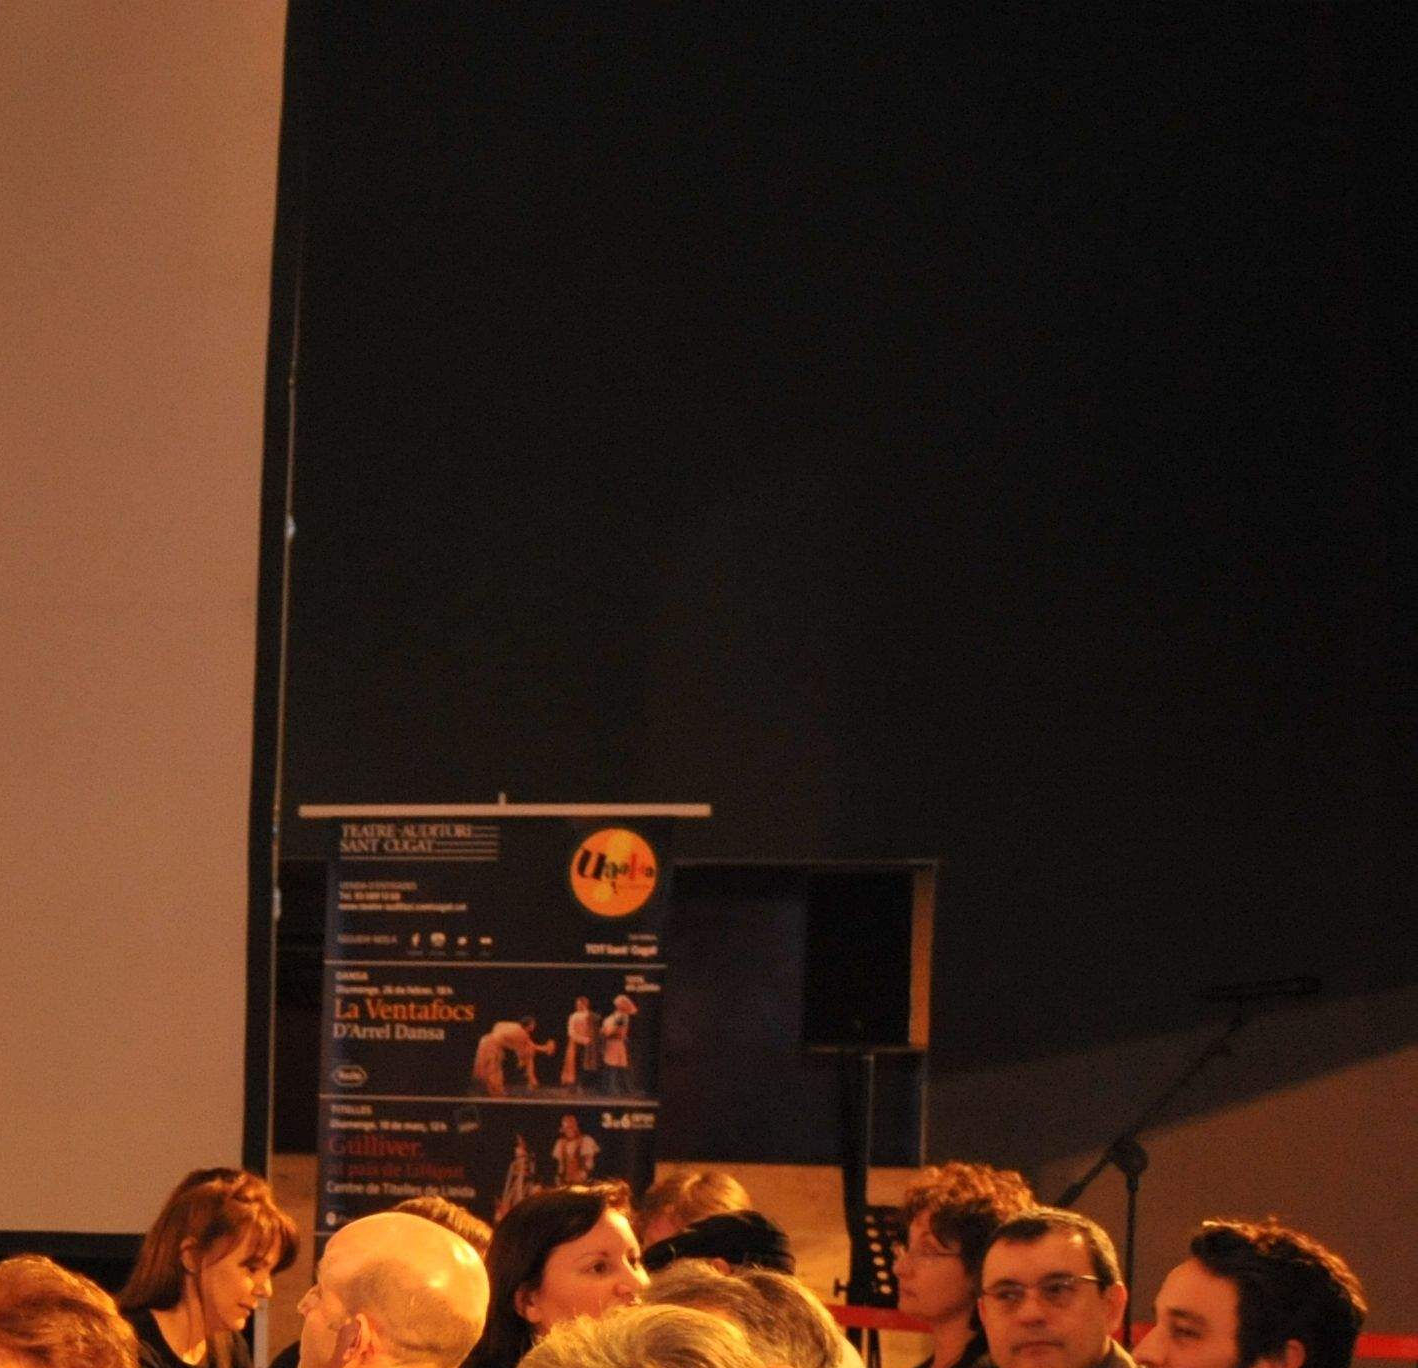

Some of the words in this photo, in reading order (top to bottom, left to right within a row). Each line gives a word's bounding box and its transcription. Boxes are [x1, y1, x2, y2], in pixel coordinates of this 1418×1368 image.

[340, 839, 378, 852] SANT
[384, 839, 433, 853] CUGAT
[335, 999, 360, 1019] La
[365, 998, 475, 1022] Ventafocs
[394, 1024, 445, 1041] Dansa
